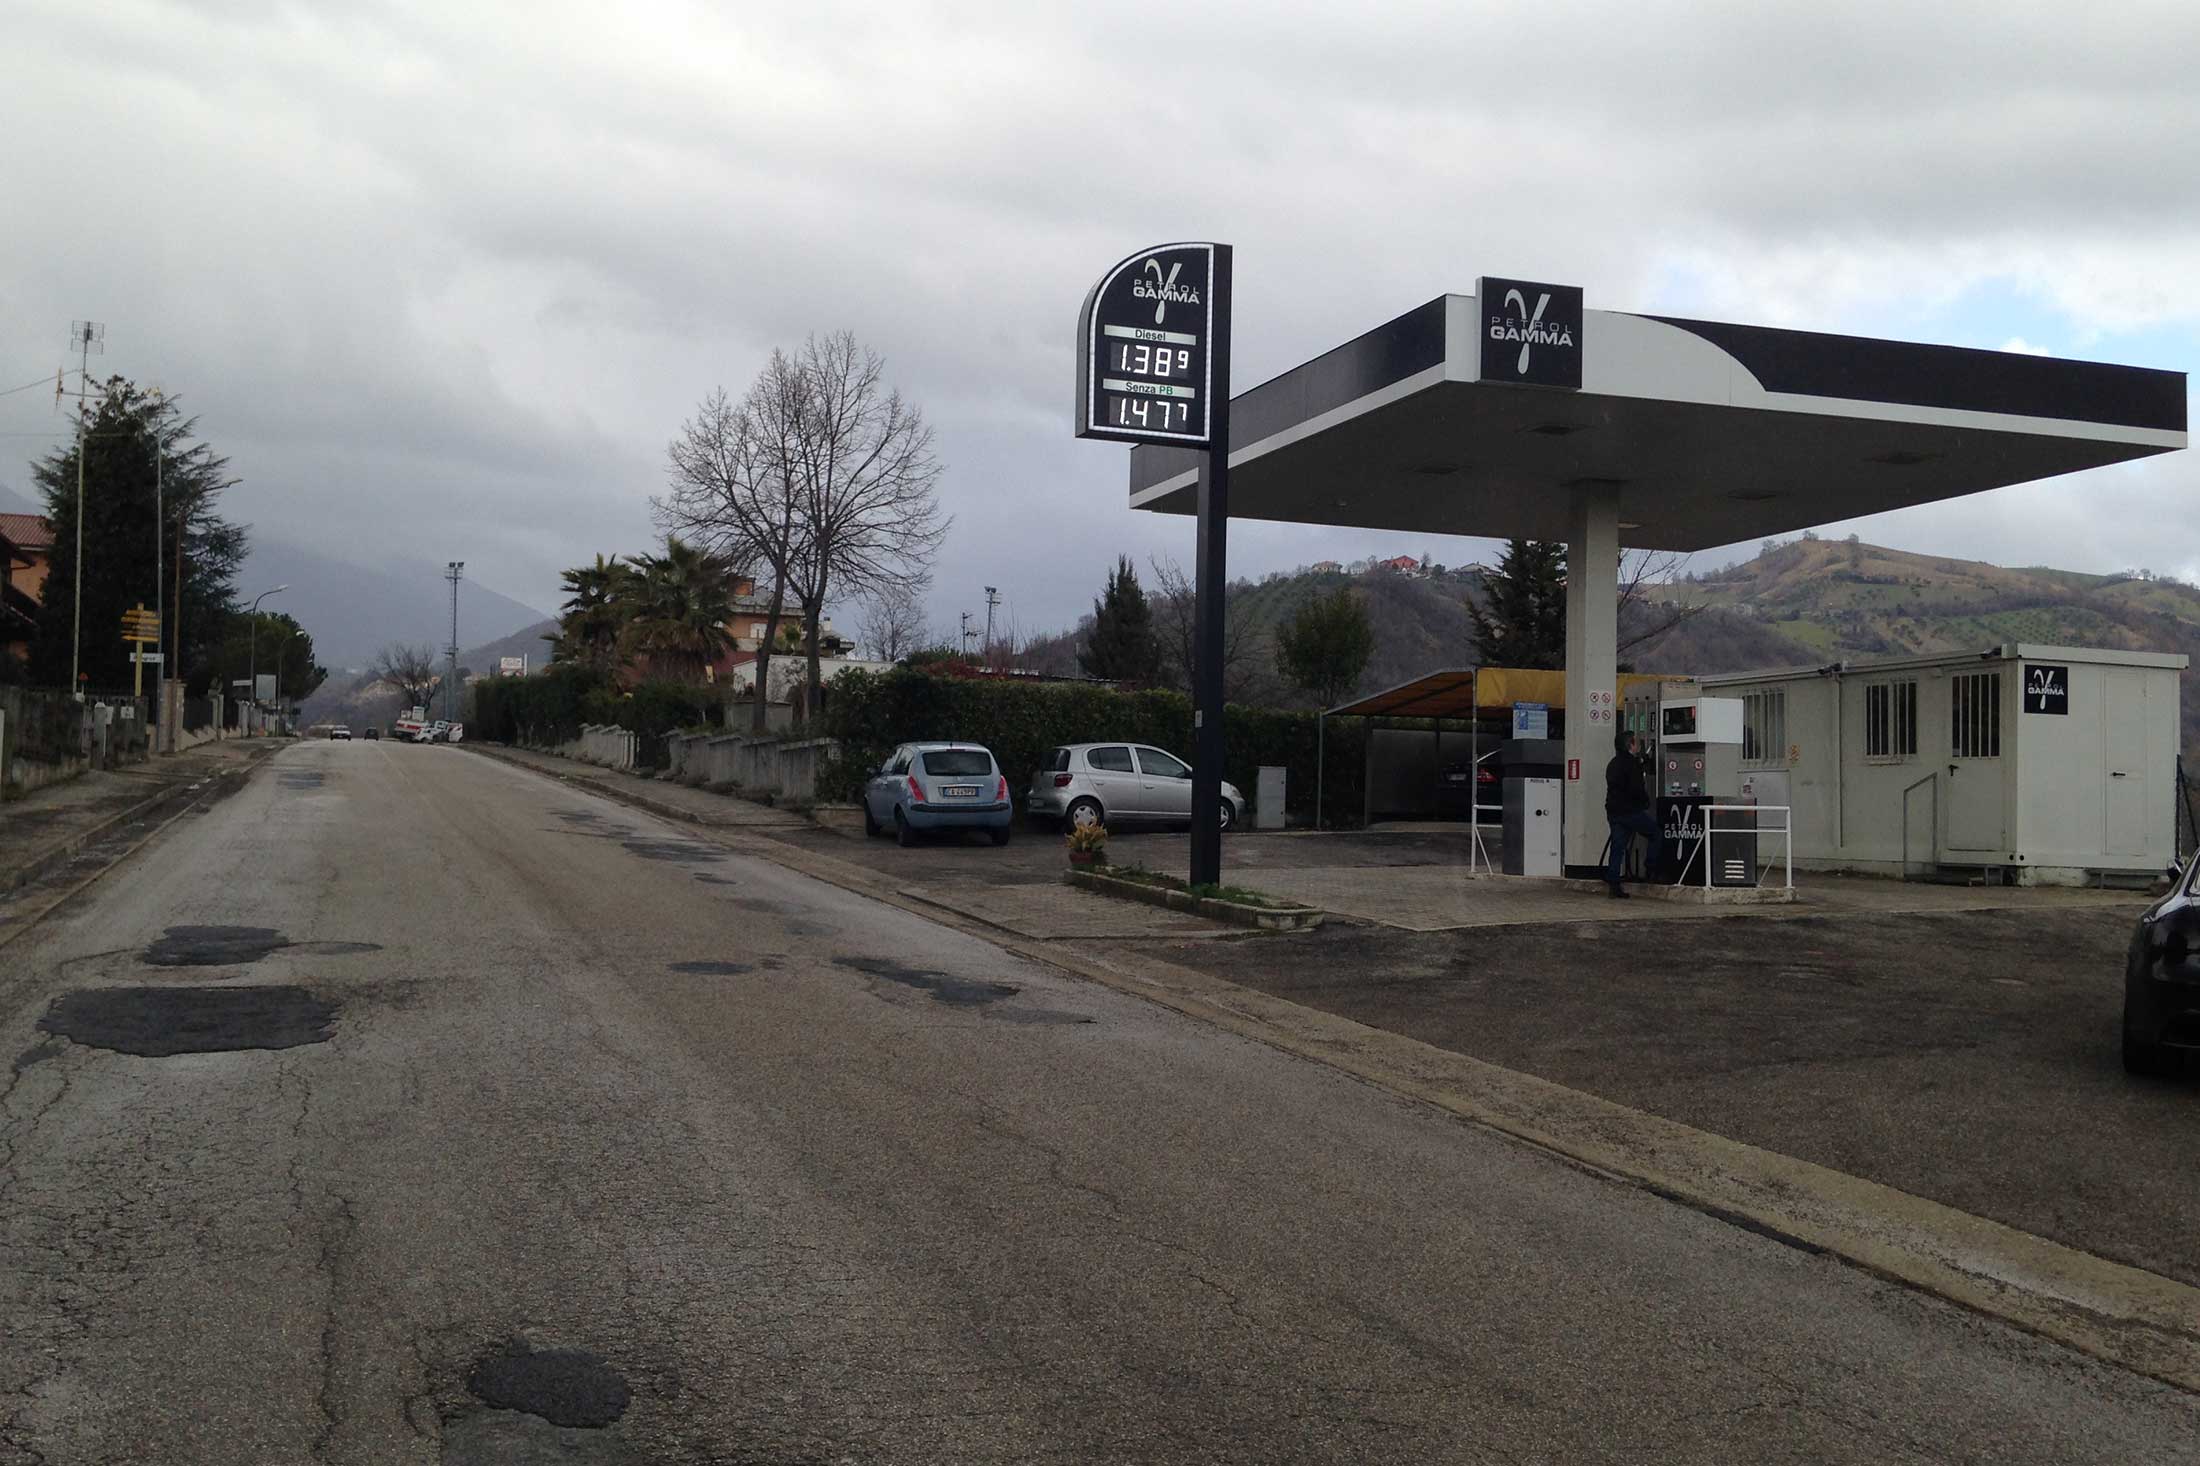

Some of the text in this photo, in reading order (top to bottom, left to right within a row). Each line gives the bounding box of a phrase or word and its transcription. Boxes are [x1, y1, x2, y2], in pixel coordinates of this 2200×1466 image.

[1134, 279, 1200, 295] PETROL
[1133, 287, 1200, 305] GAMMA
[1491, 316, 1572, 334] PETROL
[1135, 329, 1166, 341] Diesel
[1490, 326, 1573, 347] GAMMA
[1126, 382, 1174, 395] Senza PB
[2027, 687, 2065, 696] GAMMA
[1664, 830, 1704, 839] GAMMA
